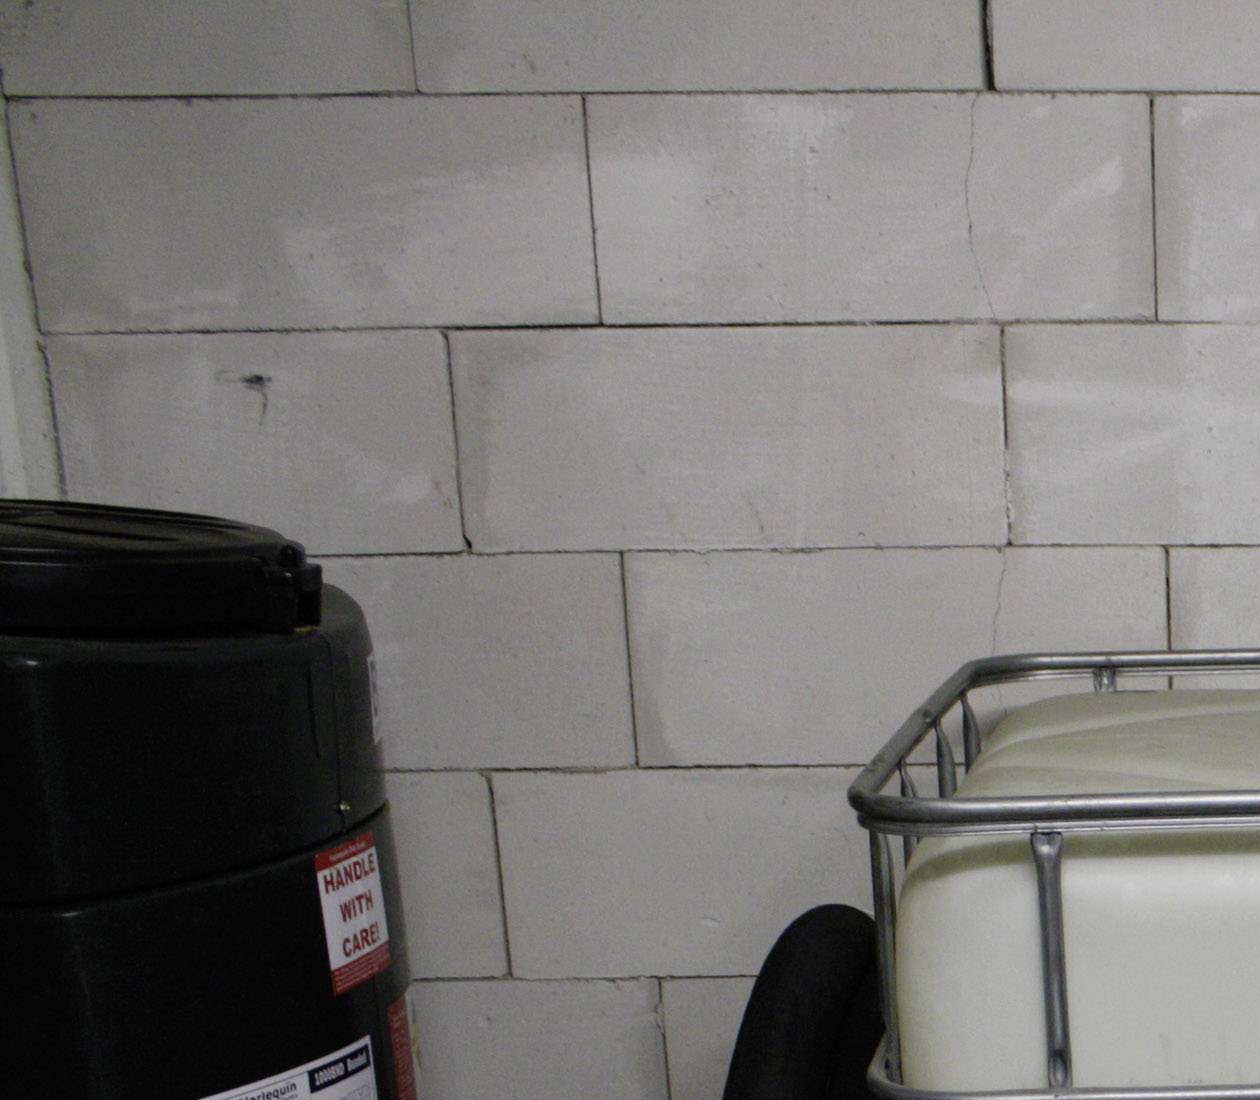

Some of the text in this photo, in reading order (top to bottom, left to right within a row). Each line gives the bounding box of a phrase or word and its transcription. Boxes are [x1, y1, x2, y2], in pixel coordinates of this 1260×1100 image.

[323, 852, 376, 894] HANDLE
[339, 889, 374, 923] WITH
[342, 921, 380, 957] CARE!
